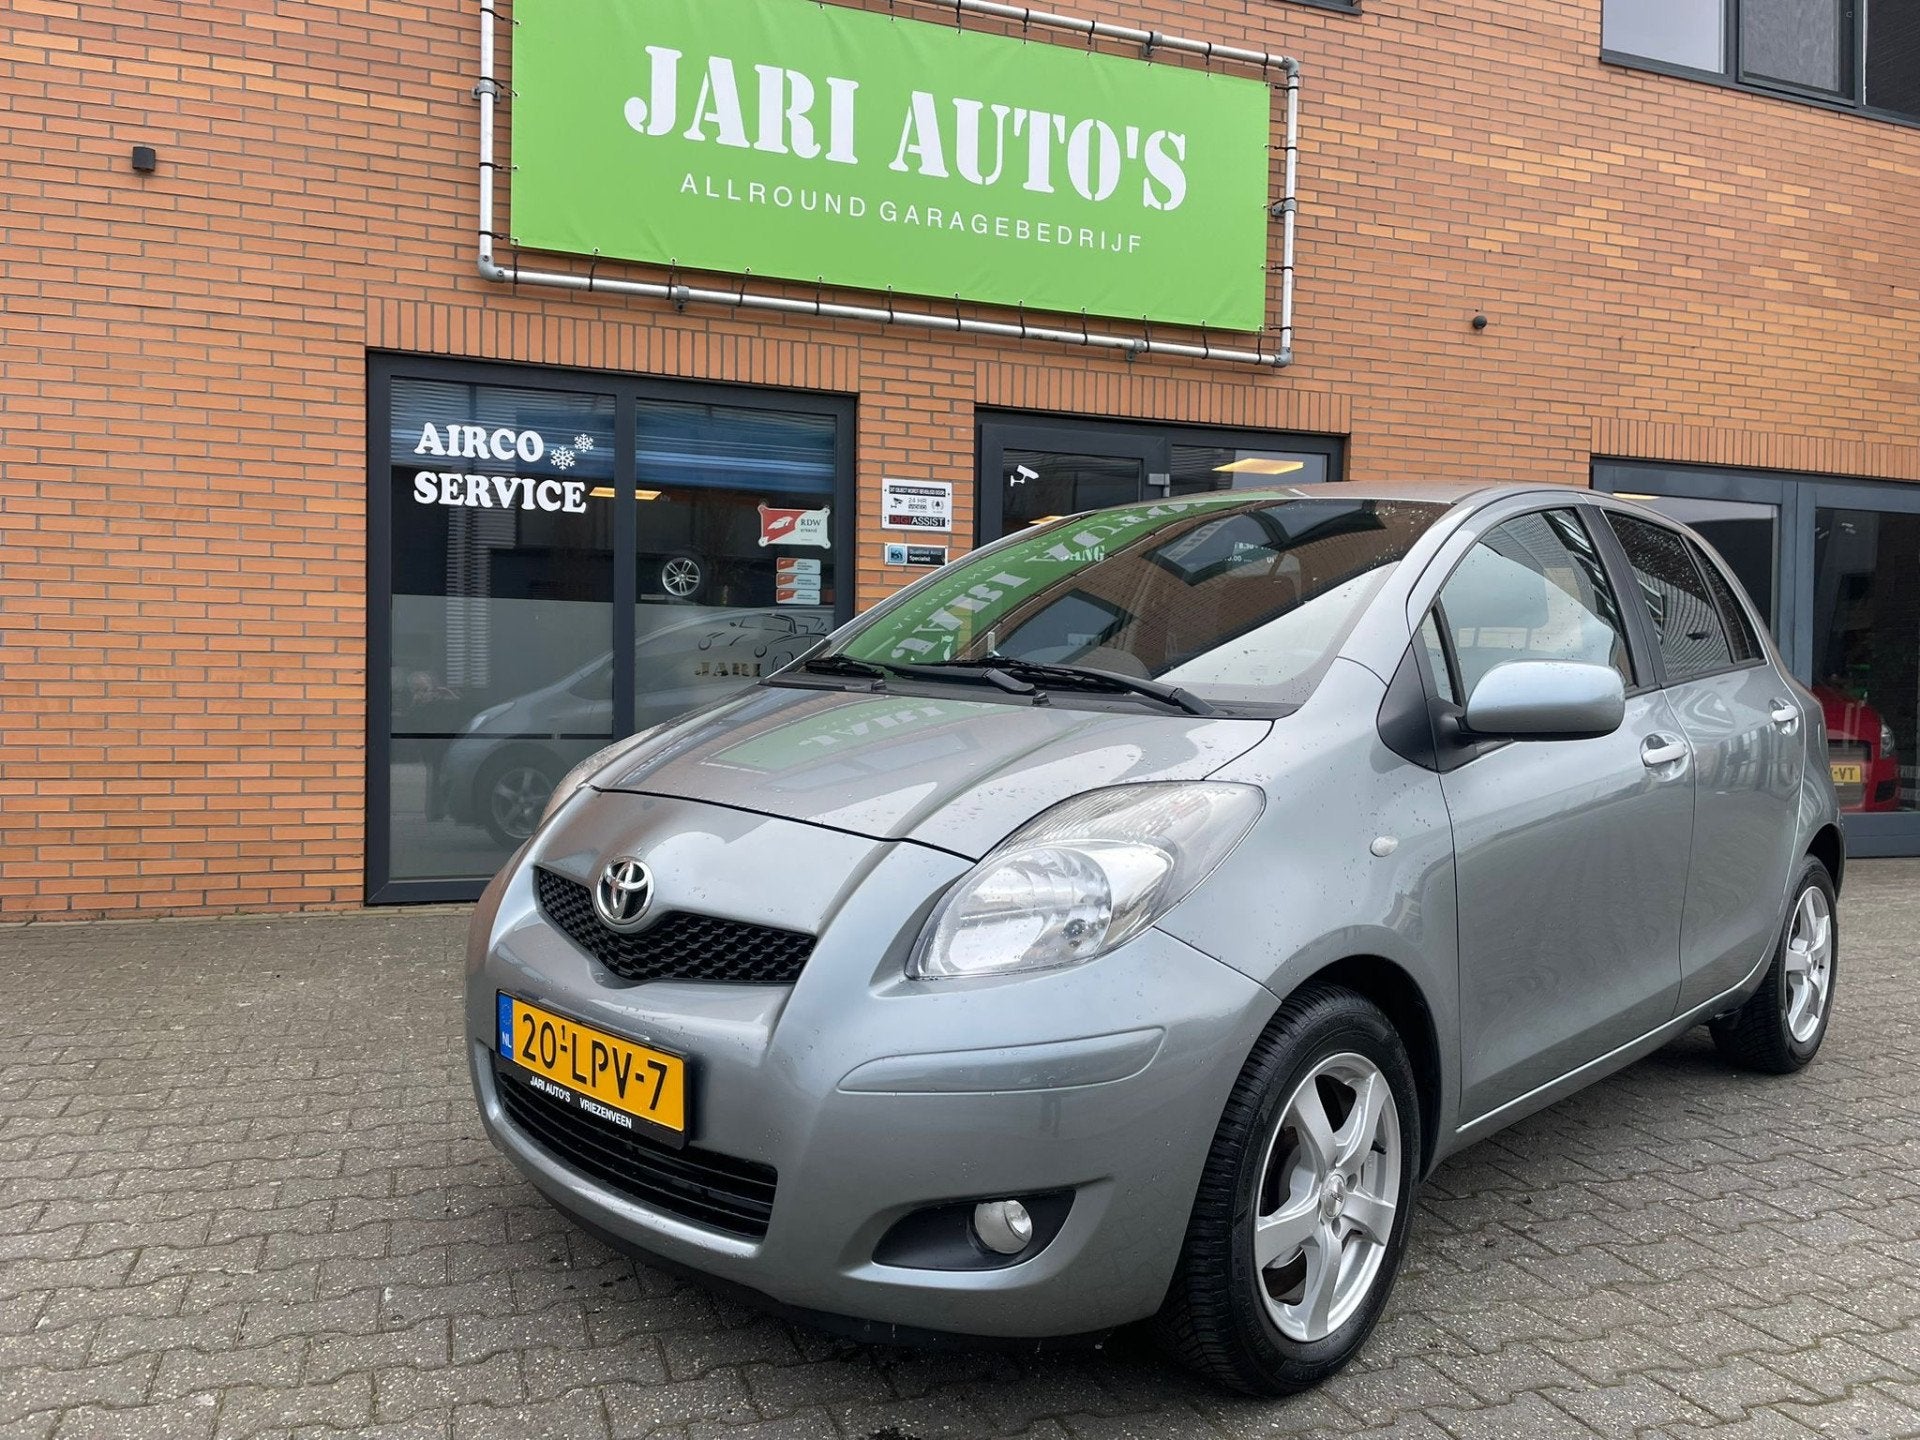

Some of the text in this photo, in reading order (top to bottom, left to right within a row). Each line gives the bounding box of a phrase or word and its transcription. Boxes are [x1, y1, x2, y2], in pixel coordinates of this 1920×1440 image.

[623, 45, 1187, 211] JARI AUTO'S
[680, 173, 1141, 253] ALLROUND GARAGEBEDRIJF
[413, 421, 545, 463] AIRCO
[413, 471, 587, 514] SERVICE
[695, 661, 761, 677] JARI
[1831, 767, 1856, 781] -VT
[501, 1032, 512, 1049] NL
[530, 1075, 632, 1129] JARI AUTO'S VRIEZENVEEN
